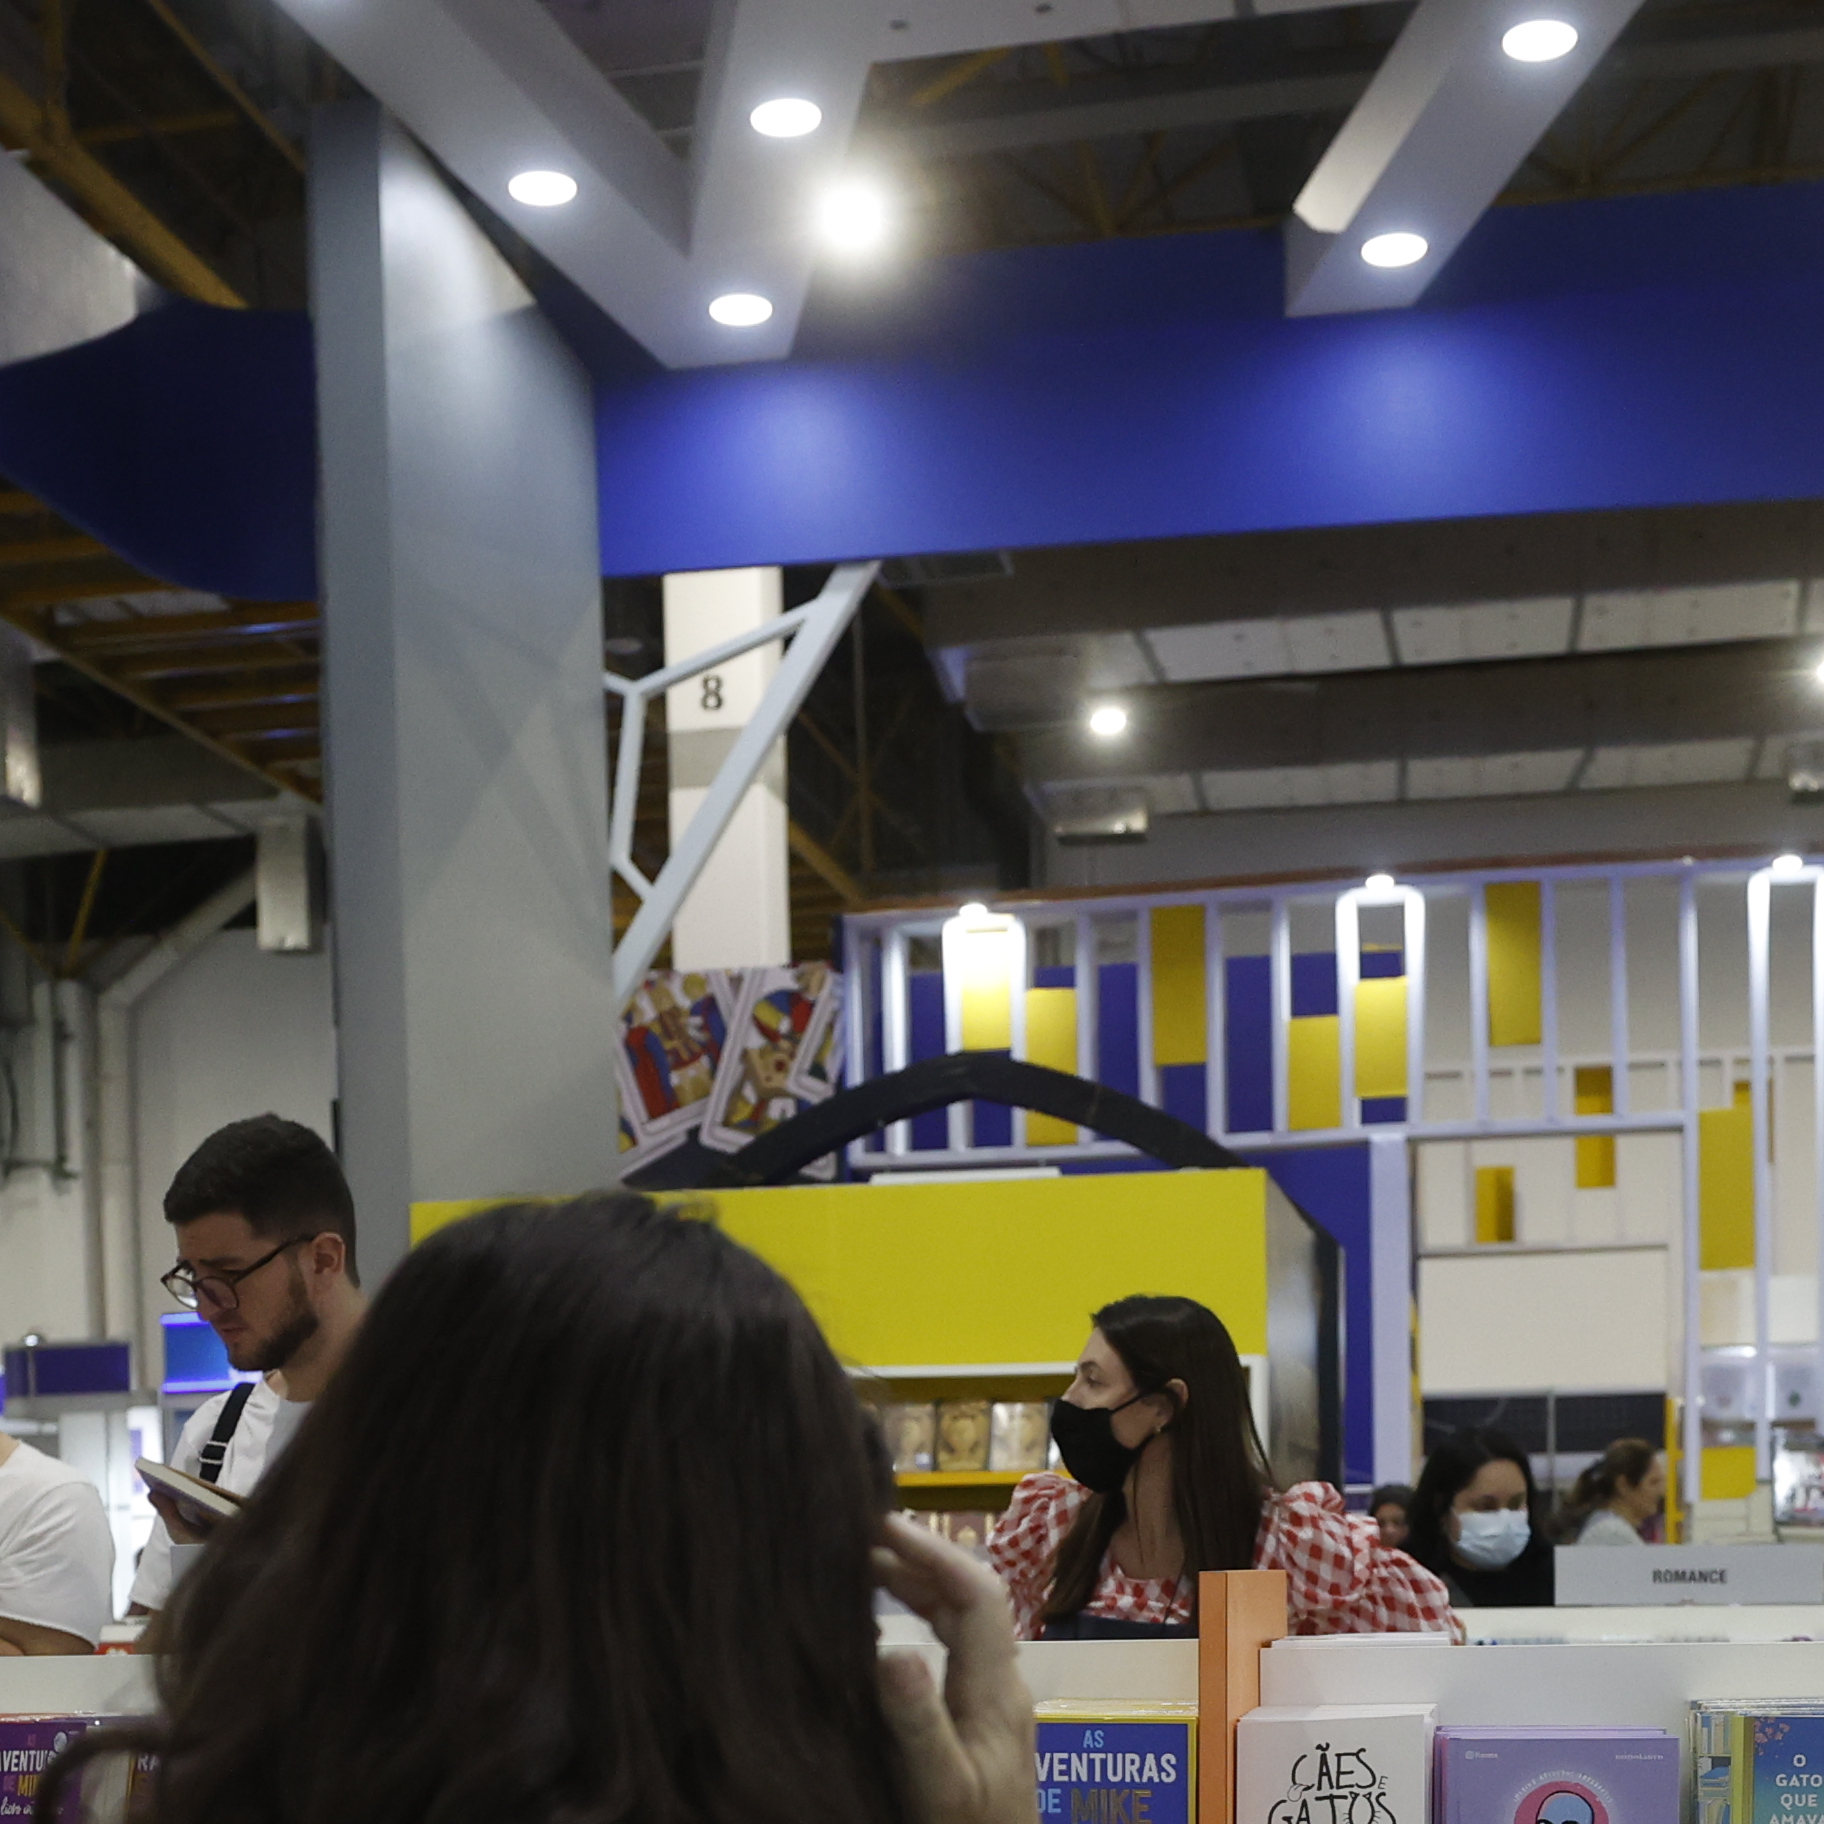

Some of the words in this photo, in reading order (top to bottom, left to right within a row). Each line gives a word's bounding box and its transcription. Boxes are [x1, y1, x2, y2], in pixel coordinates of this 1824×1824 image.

[701, 674, 723, 710] 8
[1652, 1569, 1728, 1584] ROMANCE
[1291, 1742, 1377, 1792] CÃES
[1792, 1753, 1807, 1768] O
[1775, 1774, 1823, 1788] GATO
[1779, 1793, 1819, 1809] QUE
